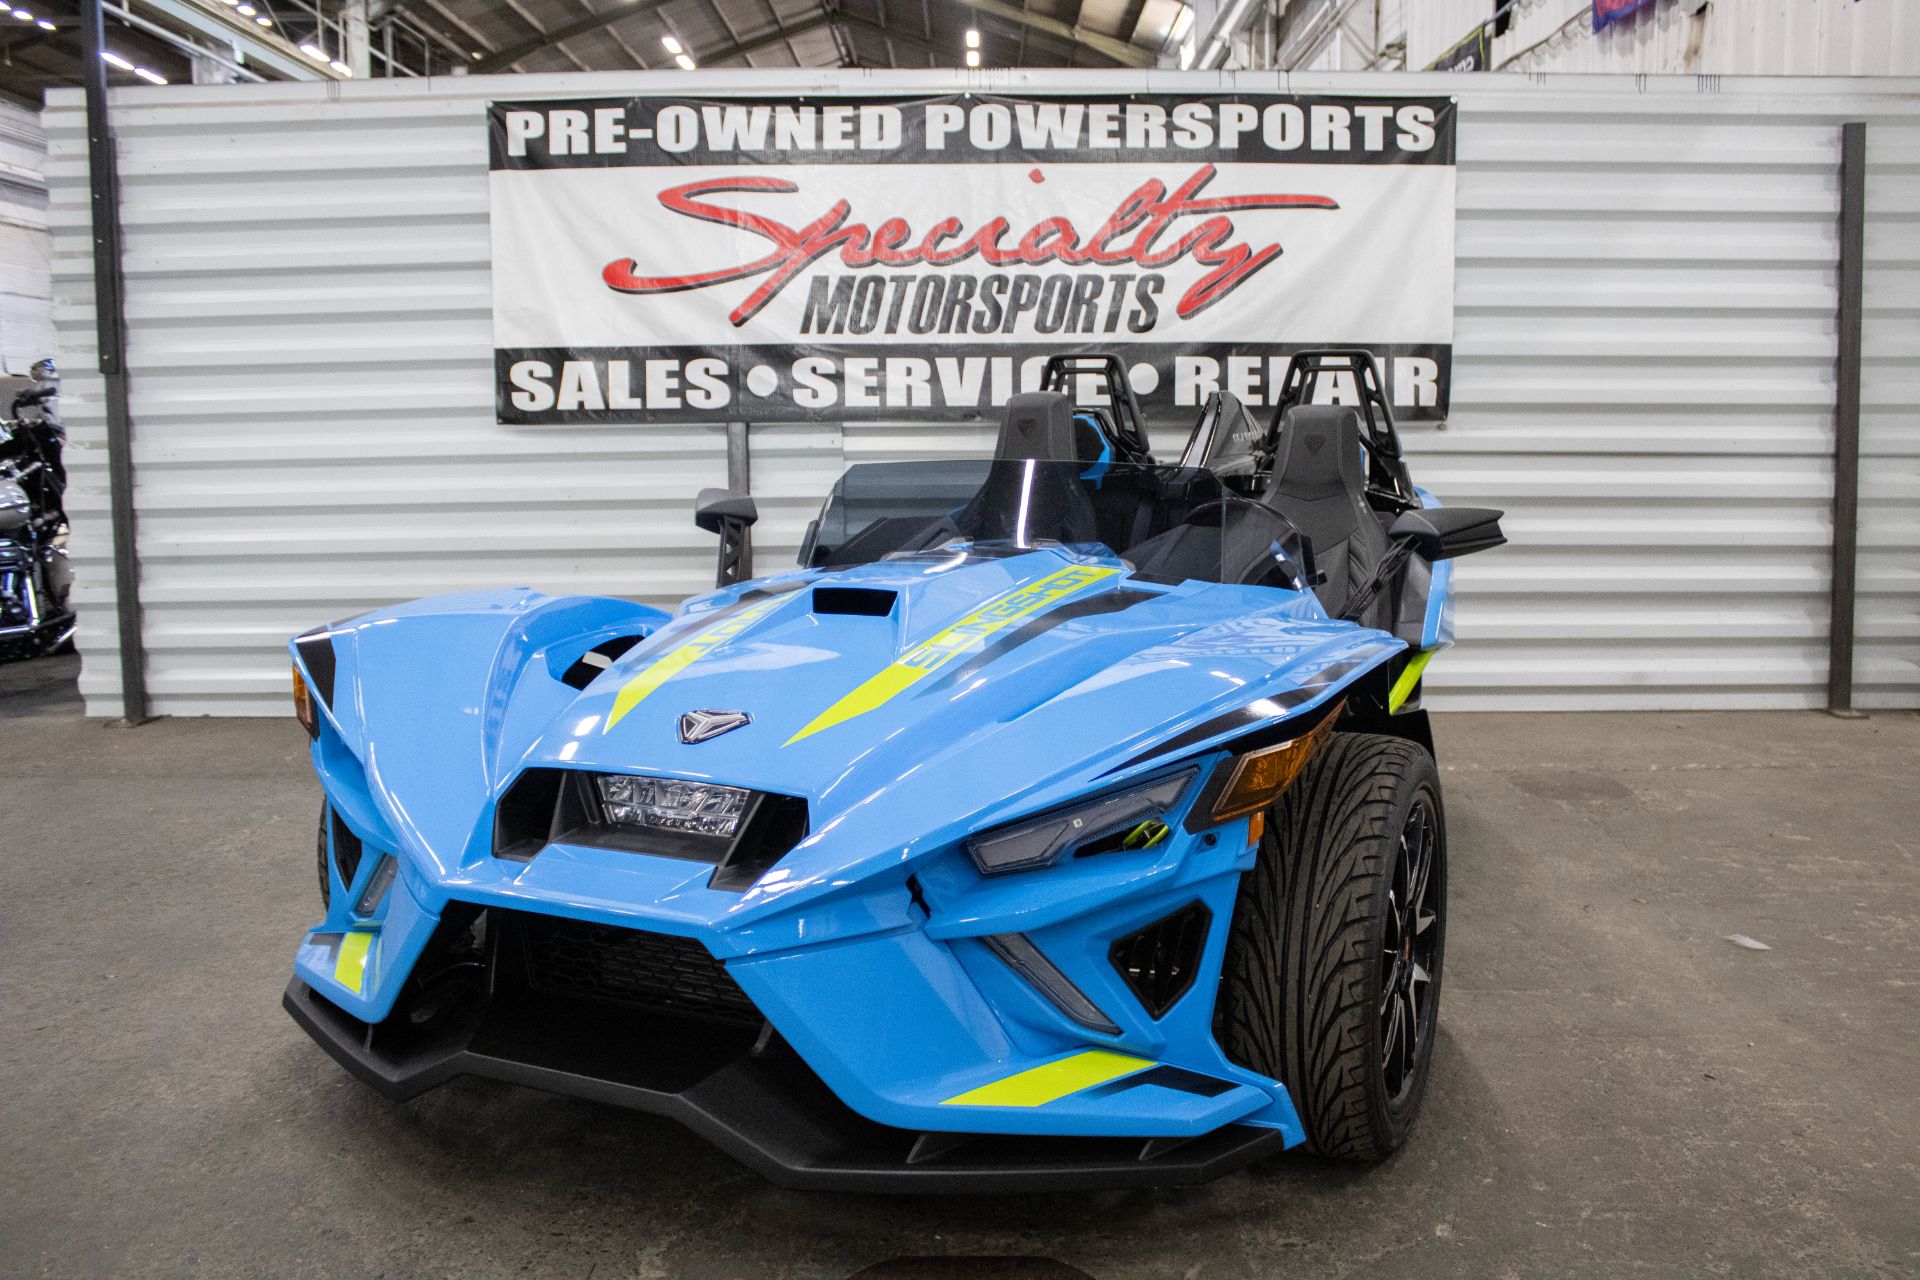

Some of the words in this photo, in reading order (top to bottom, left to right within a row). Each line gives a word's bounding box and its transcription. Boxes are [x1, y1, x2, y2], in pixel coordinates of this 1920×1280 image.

[505, 105, 902, 157] PRE-OWNED
[925, 102, 1436, 153] POWERSPORTS
[602, 162, 1340, 328] Specialty
[799, 273, 1165, 335] MOTORSPORTS
[509, 357, 730, 412] SALES
[902, 569, 1096, 669] SLINGSHOT
